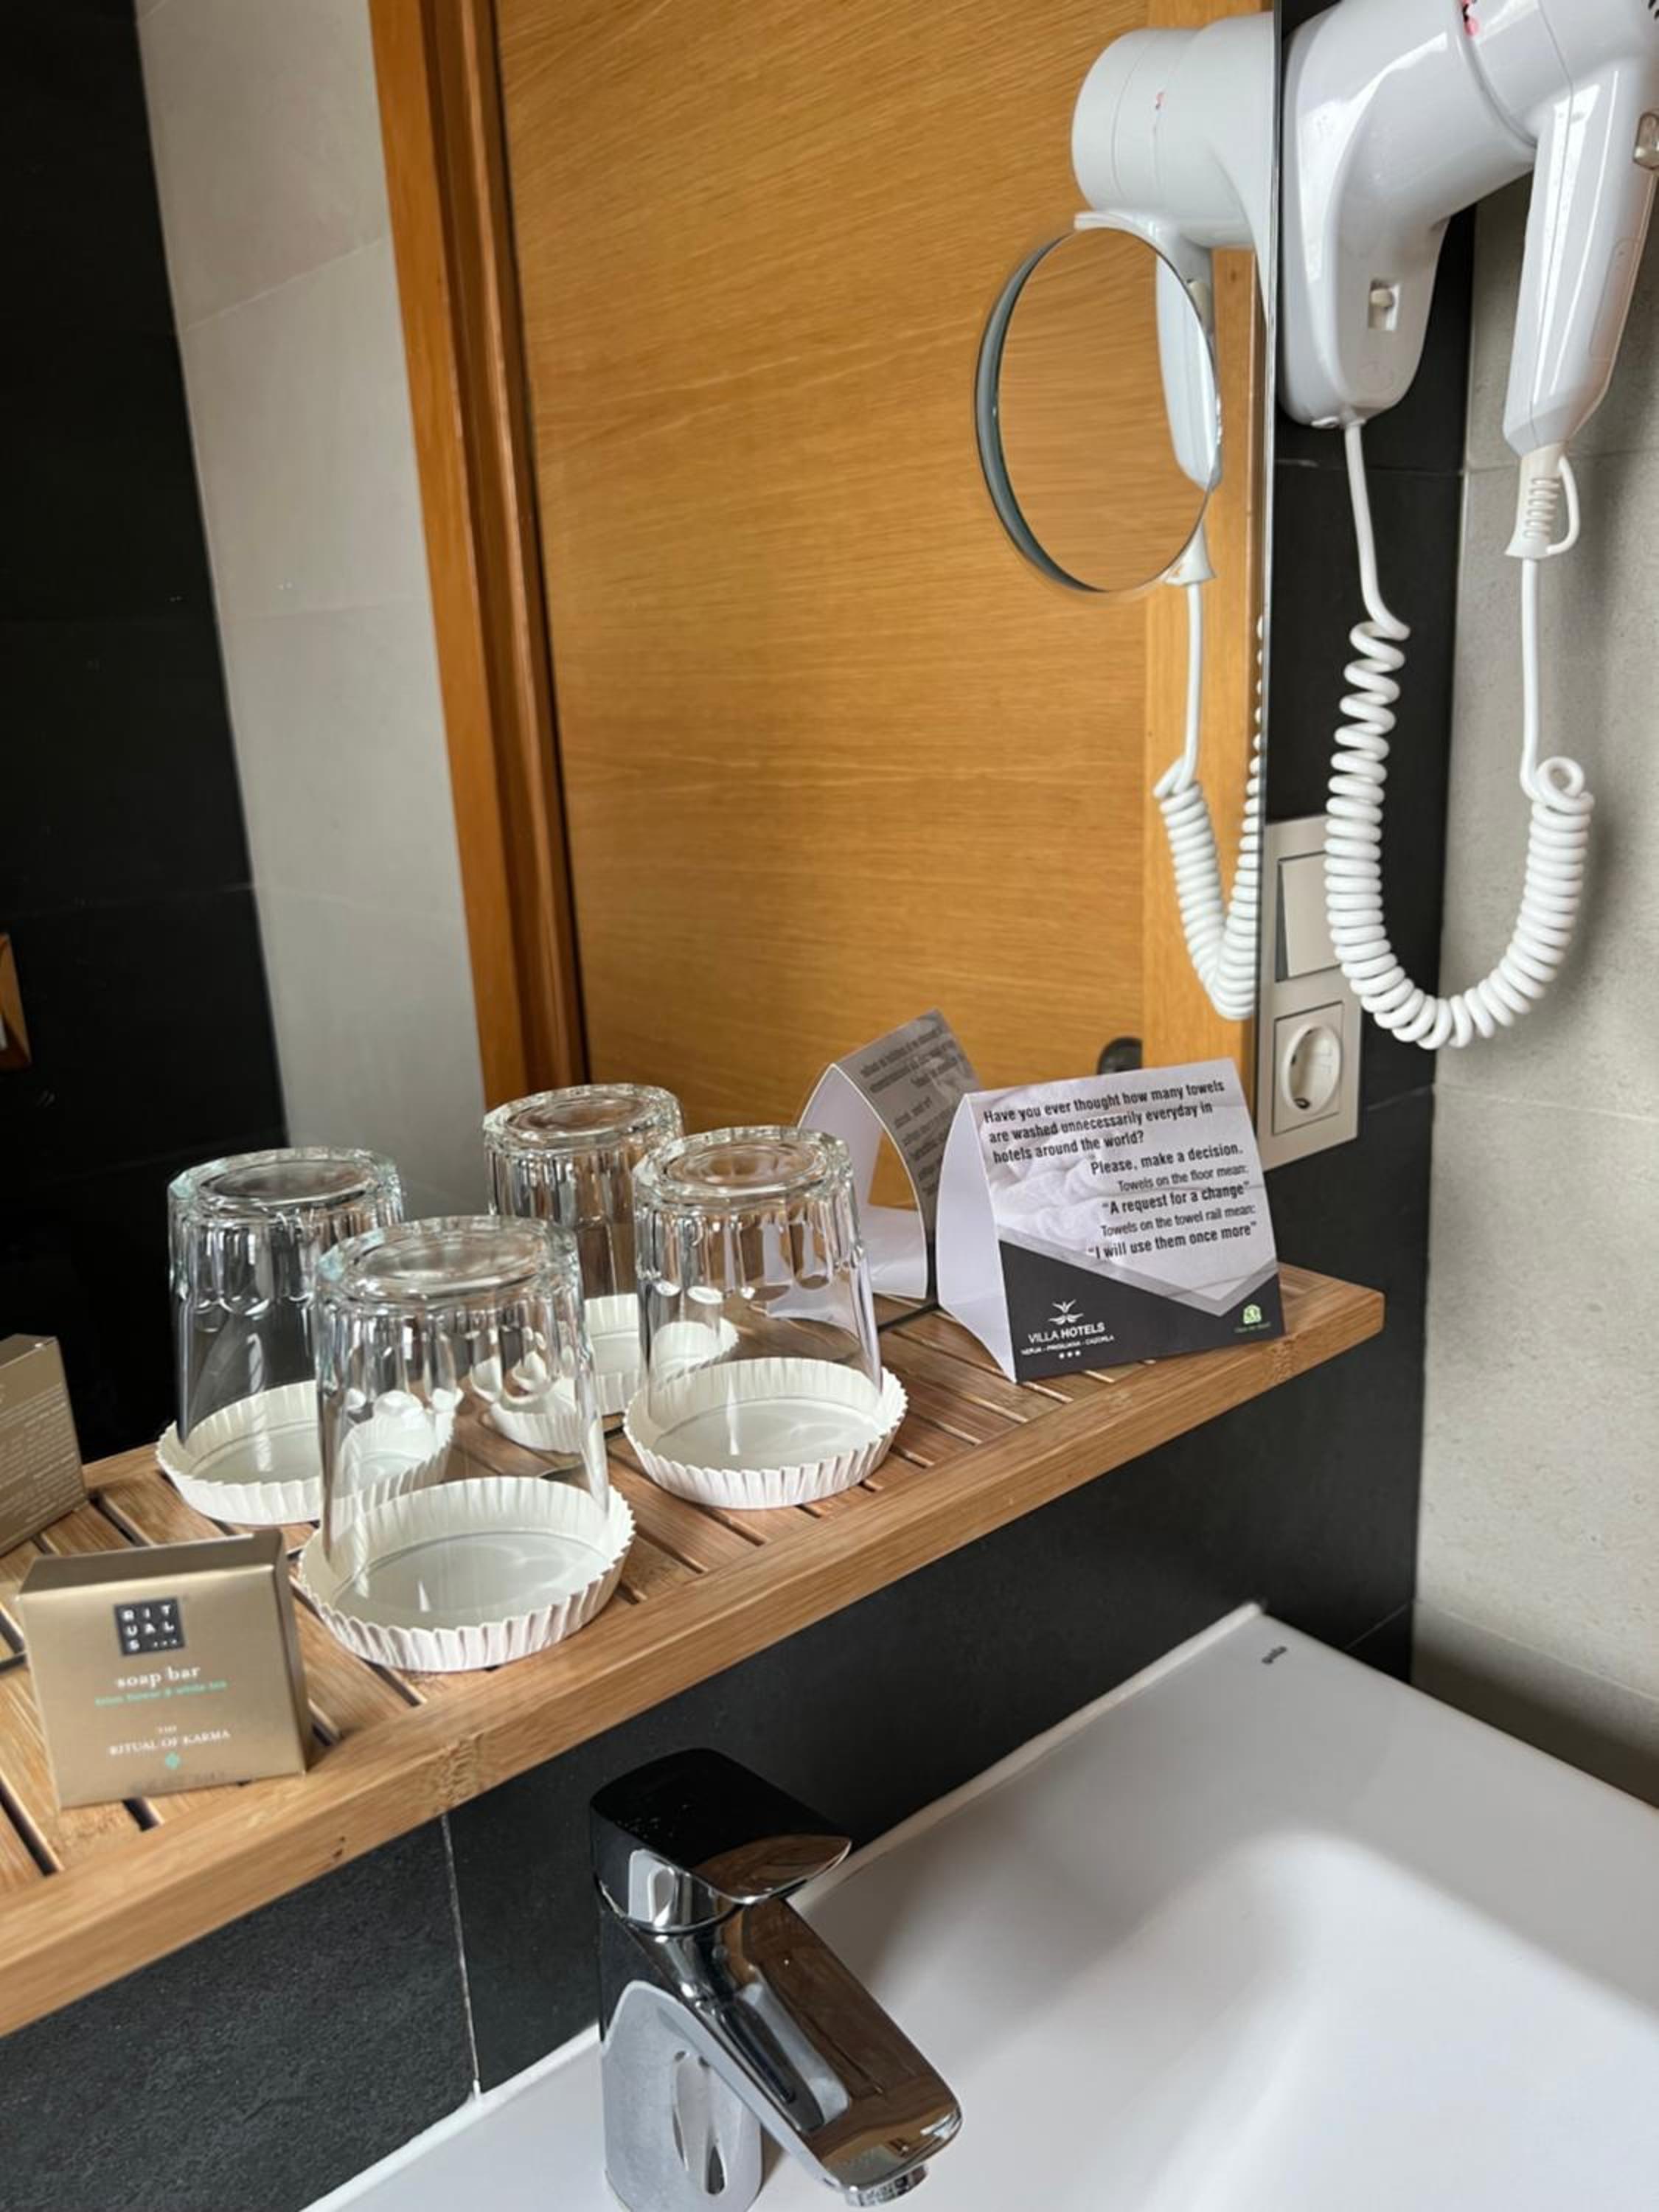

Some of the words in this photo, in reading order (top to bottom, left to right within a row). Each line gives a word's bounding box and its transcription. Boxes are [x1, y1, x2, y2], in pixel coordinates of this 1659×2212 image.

[984, 1109, 1016, 1123] Have
[1018, 1107, 1041, 1121] you
[1044, 1102, 1071, 1115] ever
[1074, 1093, 1121, 1110] thought
[1121, 1092, 1148, 1105] how
[1151, 1087, 1183, 1100] many
[1186, 1079, 1225, 1096] towels
[989, 1131, 1009, 1143] are
[1011, 1122, 1058, 1140] washed
[1060, 1110, 1142, 1133] unnecessarily
[1145, 1105, 1197, 1121] everyday
[1200, 1102, 1213, 1113] in
[992, 1147, 1032, 1164] hotels
[1035, 1140, 1078, 1158] around
[1080, 1137, 1100, 1151] the
[1103, 1130, 1144, 1147] world?
[1141, 1152, 1174, 1168] make
[1177, 1152, 1185, 1163] a
[1188, 1144, 1244, 1161] decision.
[1118, 1178, 1154, 1192] Towels
[1156, 1176, 1170, 1186] on
[1171, 1173, 1189, 1184] the
[1190, 1169, 1214, 1180] floor
[1121, 1194, 1167, 1212] request
[1169, 1191, 1187, 1205] for
[1190, 1191, 1199, 1203] a
[1100, 1222, 1138, 1237] Towels
[1139, 1220, 1153, 1231] on
[1155, 1217, 1173, 1228] the
[1175, 1211, 1203, 1225] towel
[1205, 1208, 1222, 1220] rail
[1103, 1242, 1127, 1257] will
[1130, 1240, 1152, 1253] use
[1155, 1235, 1186, 1250] them
[1189, 1230, 1217, 1245] once
[1027, 1330, 1059, 1343] VILLA
[1060, 1322, 1105, 1339] HOTELS
[116, 1672, 161, 1689] soap
[167, 1665, 201, 1681] bar
[110, 1739, 156, 1756] RITUAL
[161, 1736, 178, 1747] OF
[183, 1729, 231, 1745] KARMA
